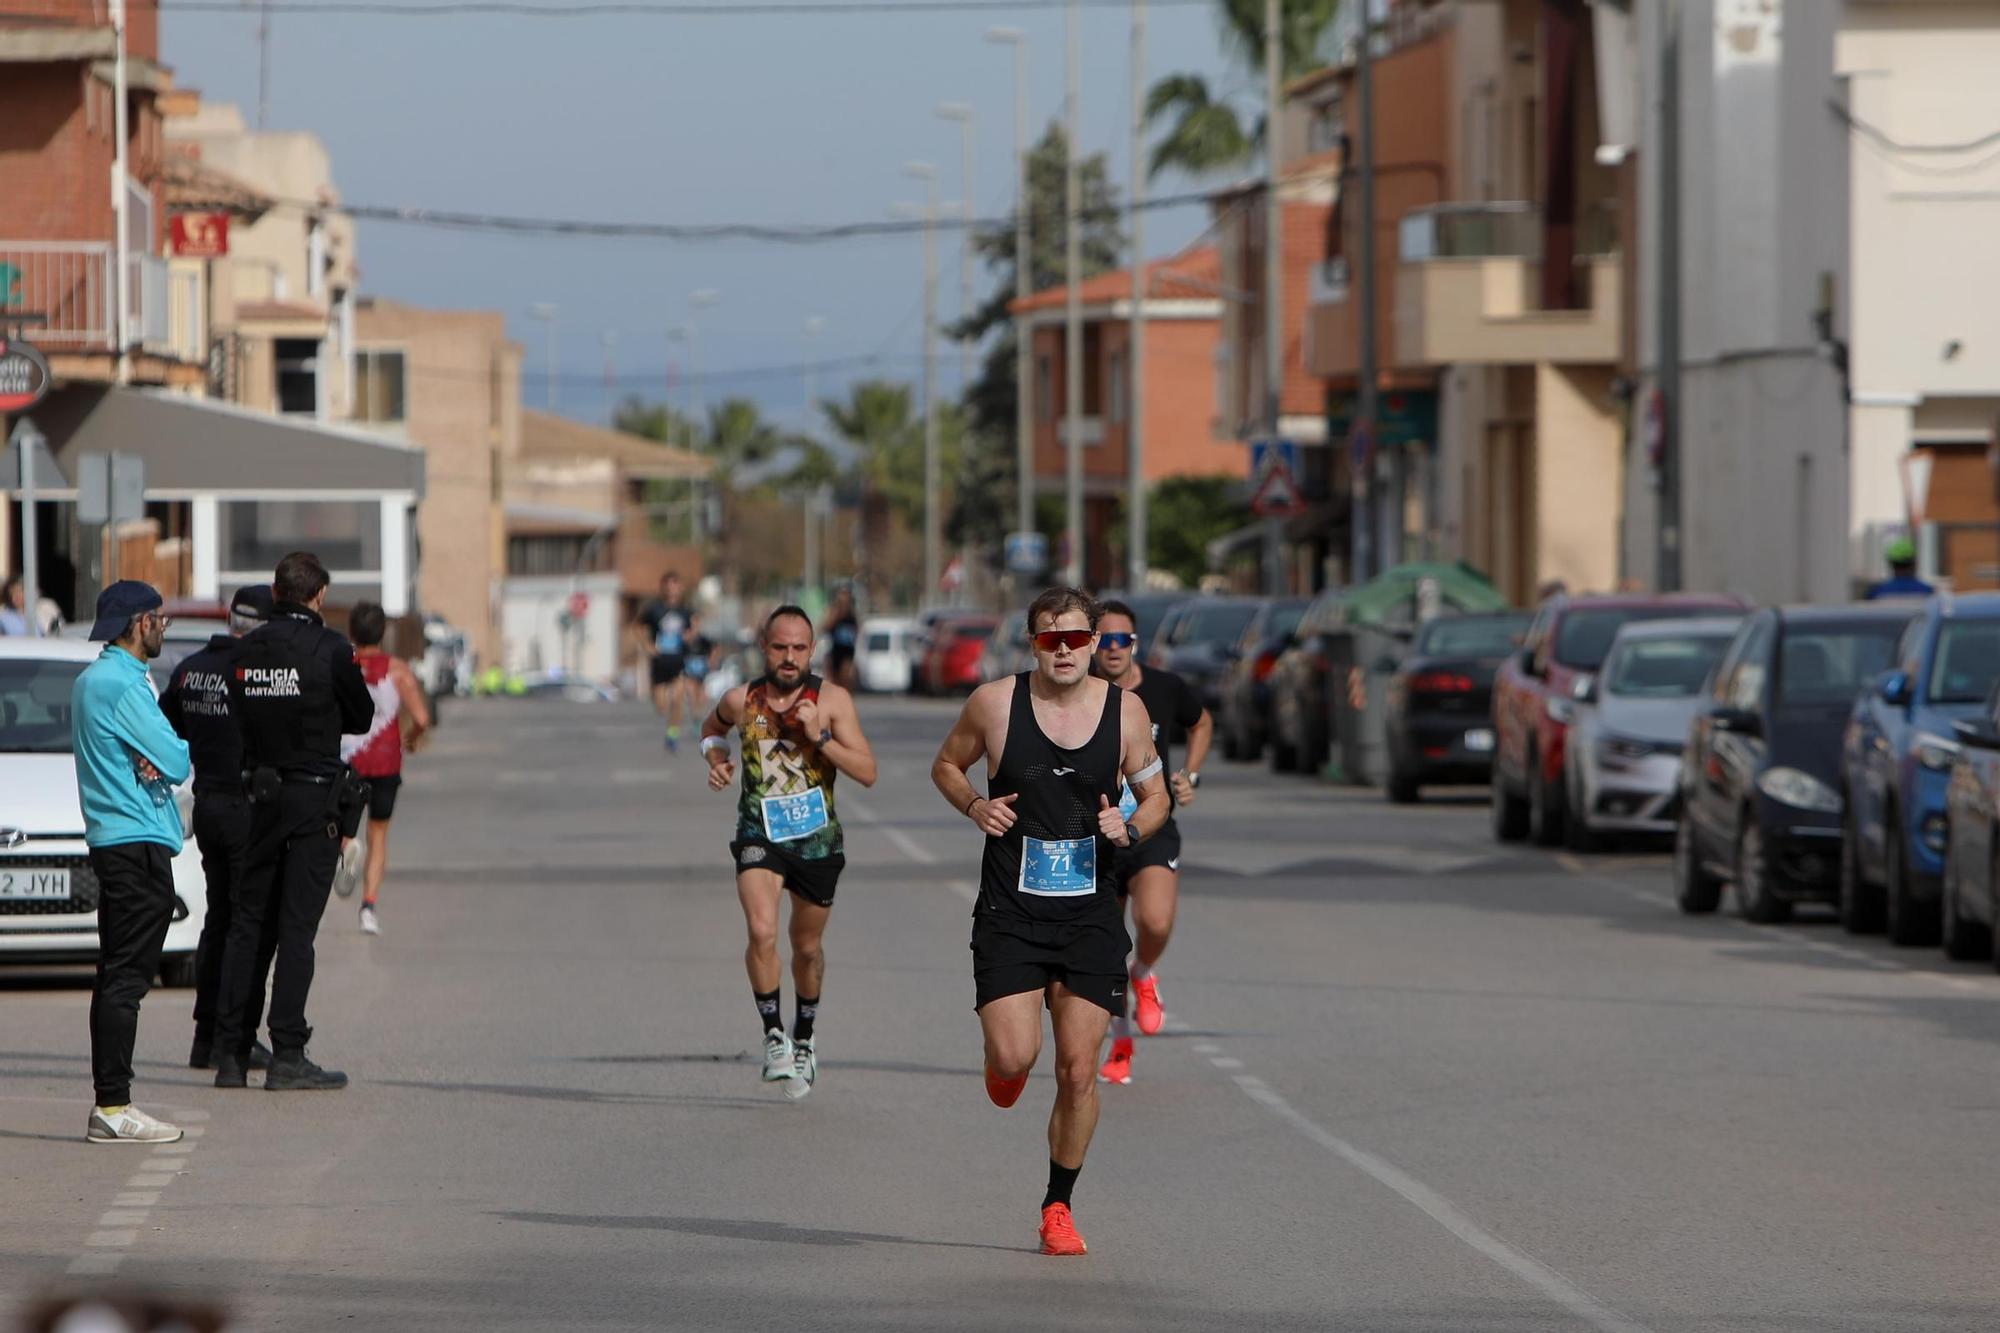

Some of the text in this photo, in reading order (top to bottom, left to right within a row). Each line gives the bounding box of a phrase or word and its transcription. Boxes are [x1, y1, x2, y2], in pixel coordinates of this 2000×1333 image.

[183, 671, 229, 696] POLICIA
[244, 668, 299, 682] POLICIA
[244, 687, 301, 696] CARTAGENA
[783, 805, 810, 822] 152
[1049, 854, 1070, 872] 71
[24, 872, 64, 896] JYH
